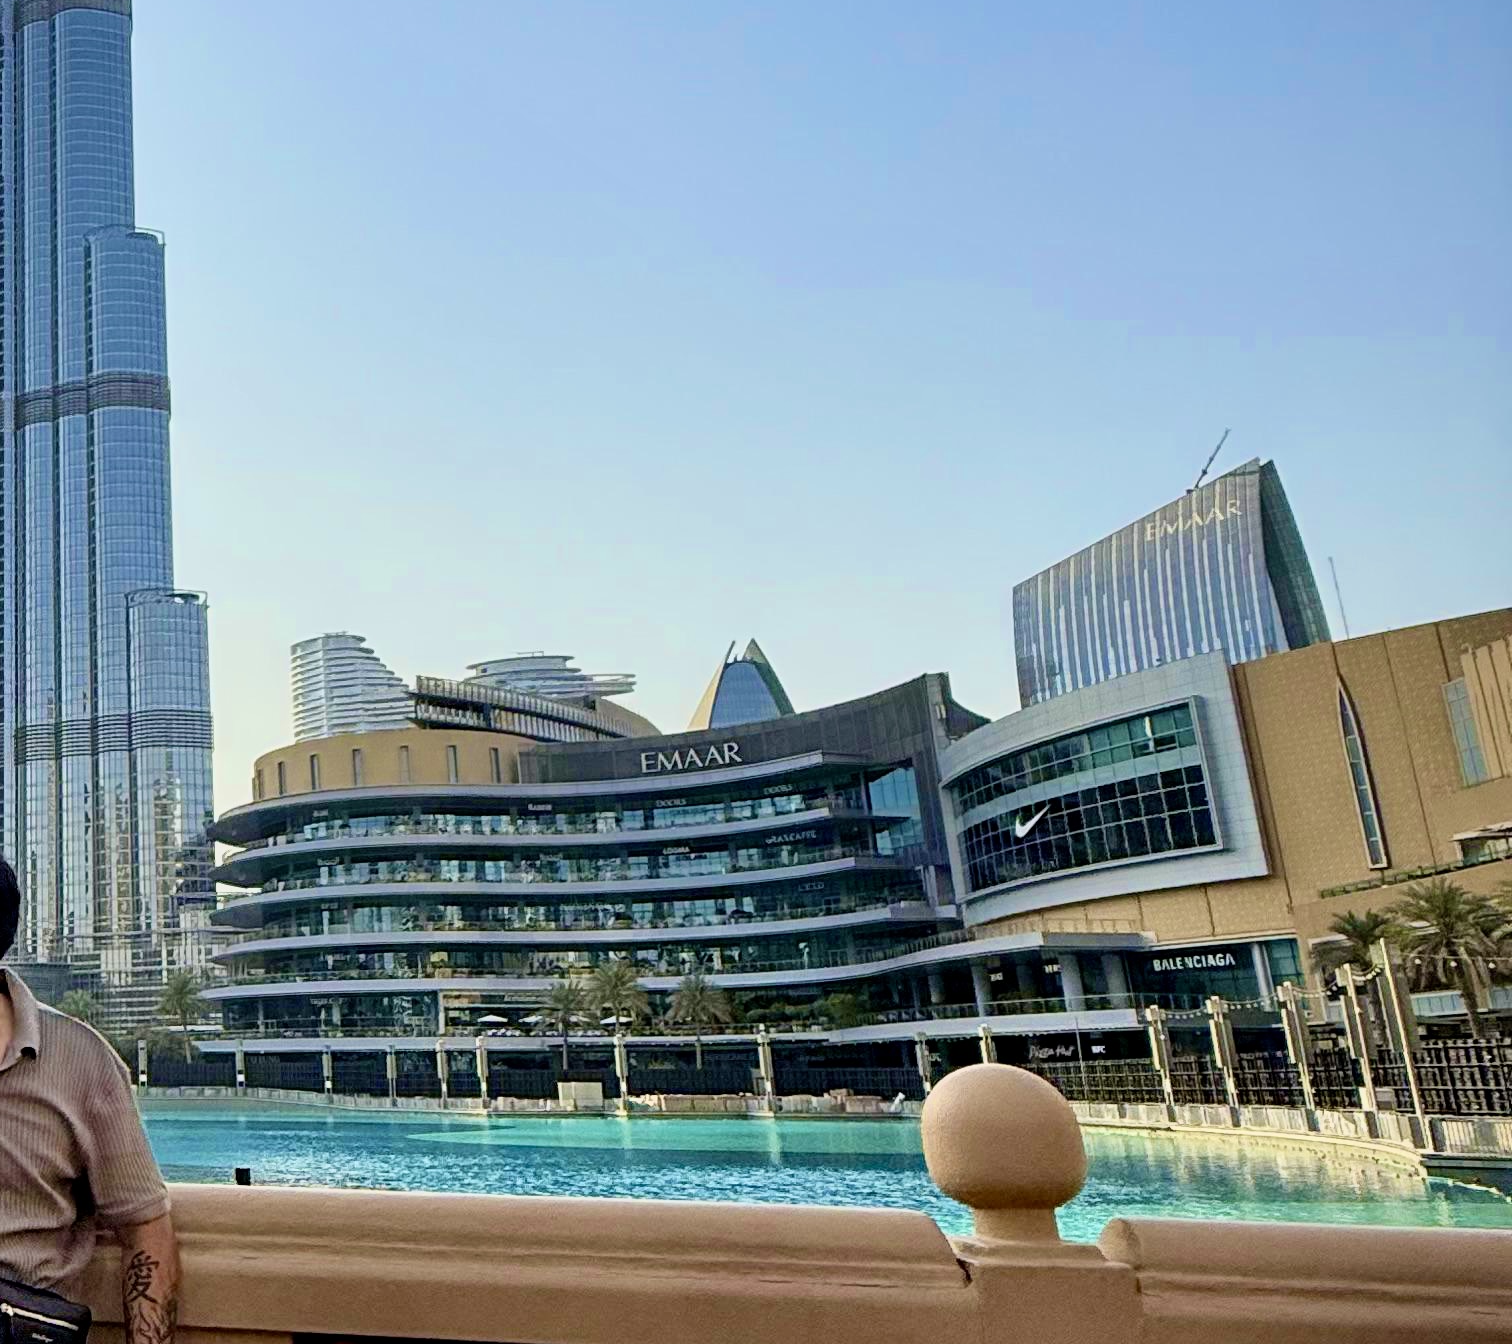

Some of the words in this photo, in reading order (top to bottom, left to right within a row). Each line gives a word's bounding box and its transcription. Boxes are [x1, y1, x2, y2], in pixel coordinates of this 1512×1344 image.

[1145, 499, 1242, 542] EMAAR
[641, 742, 743, 773] EMAAR
[1152, 953, 1236, 972] BALENCIAGA
